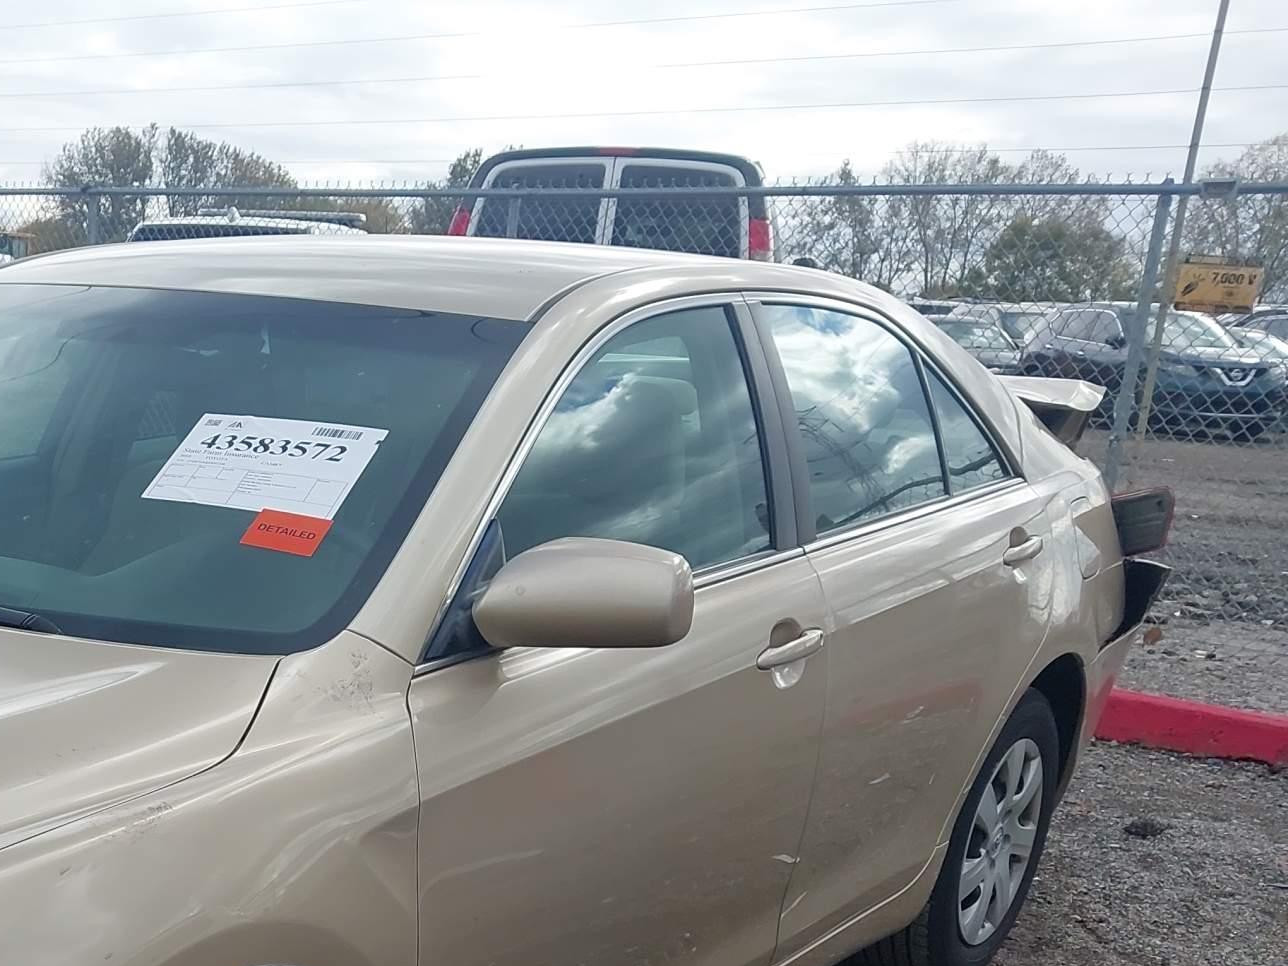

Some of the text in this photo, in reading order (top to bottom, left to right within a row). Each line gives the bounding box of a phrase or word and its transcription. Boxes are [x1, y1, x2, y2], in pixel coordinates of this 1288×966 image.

[200, 433, 348, 462] 43583572
[203, 448, 223, 456] Farm
[223, 450, 261, 460] Insurance
[257, 523, 317, 540] DETAILED
